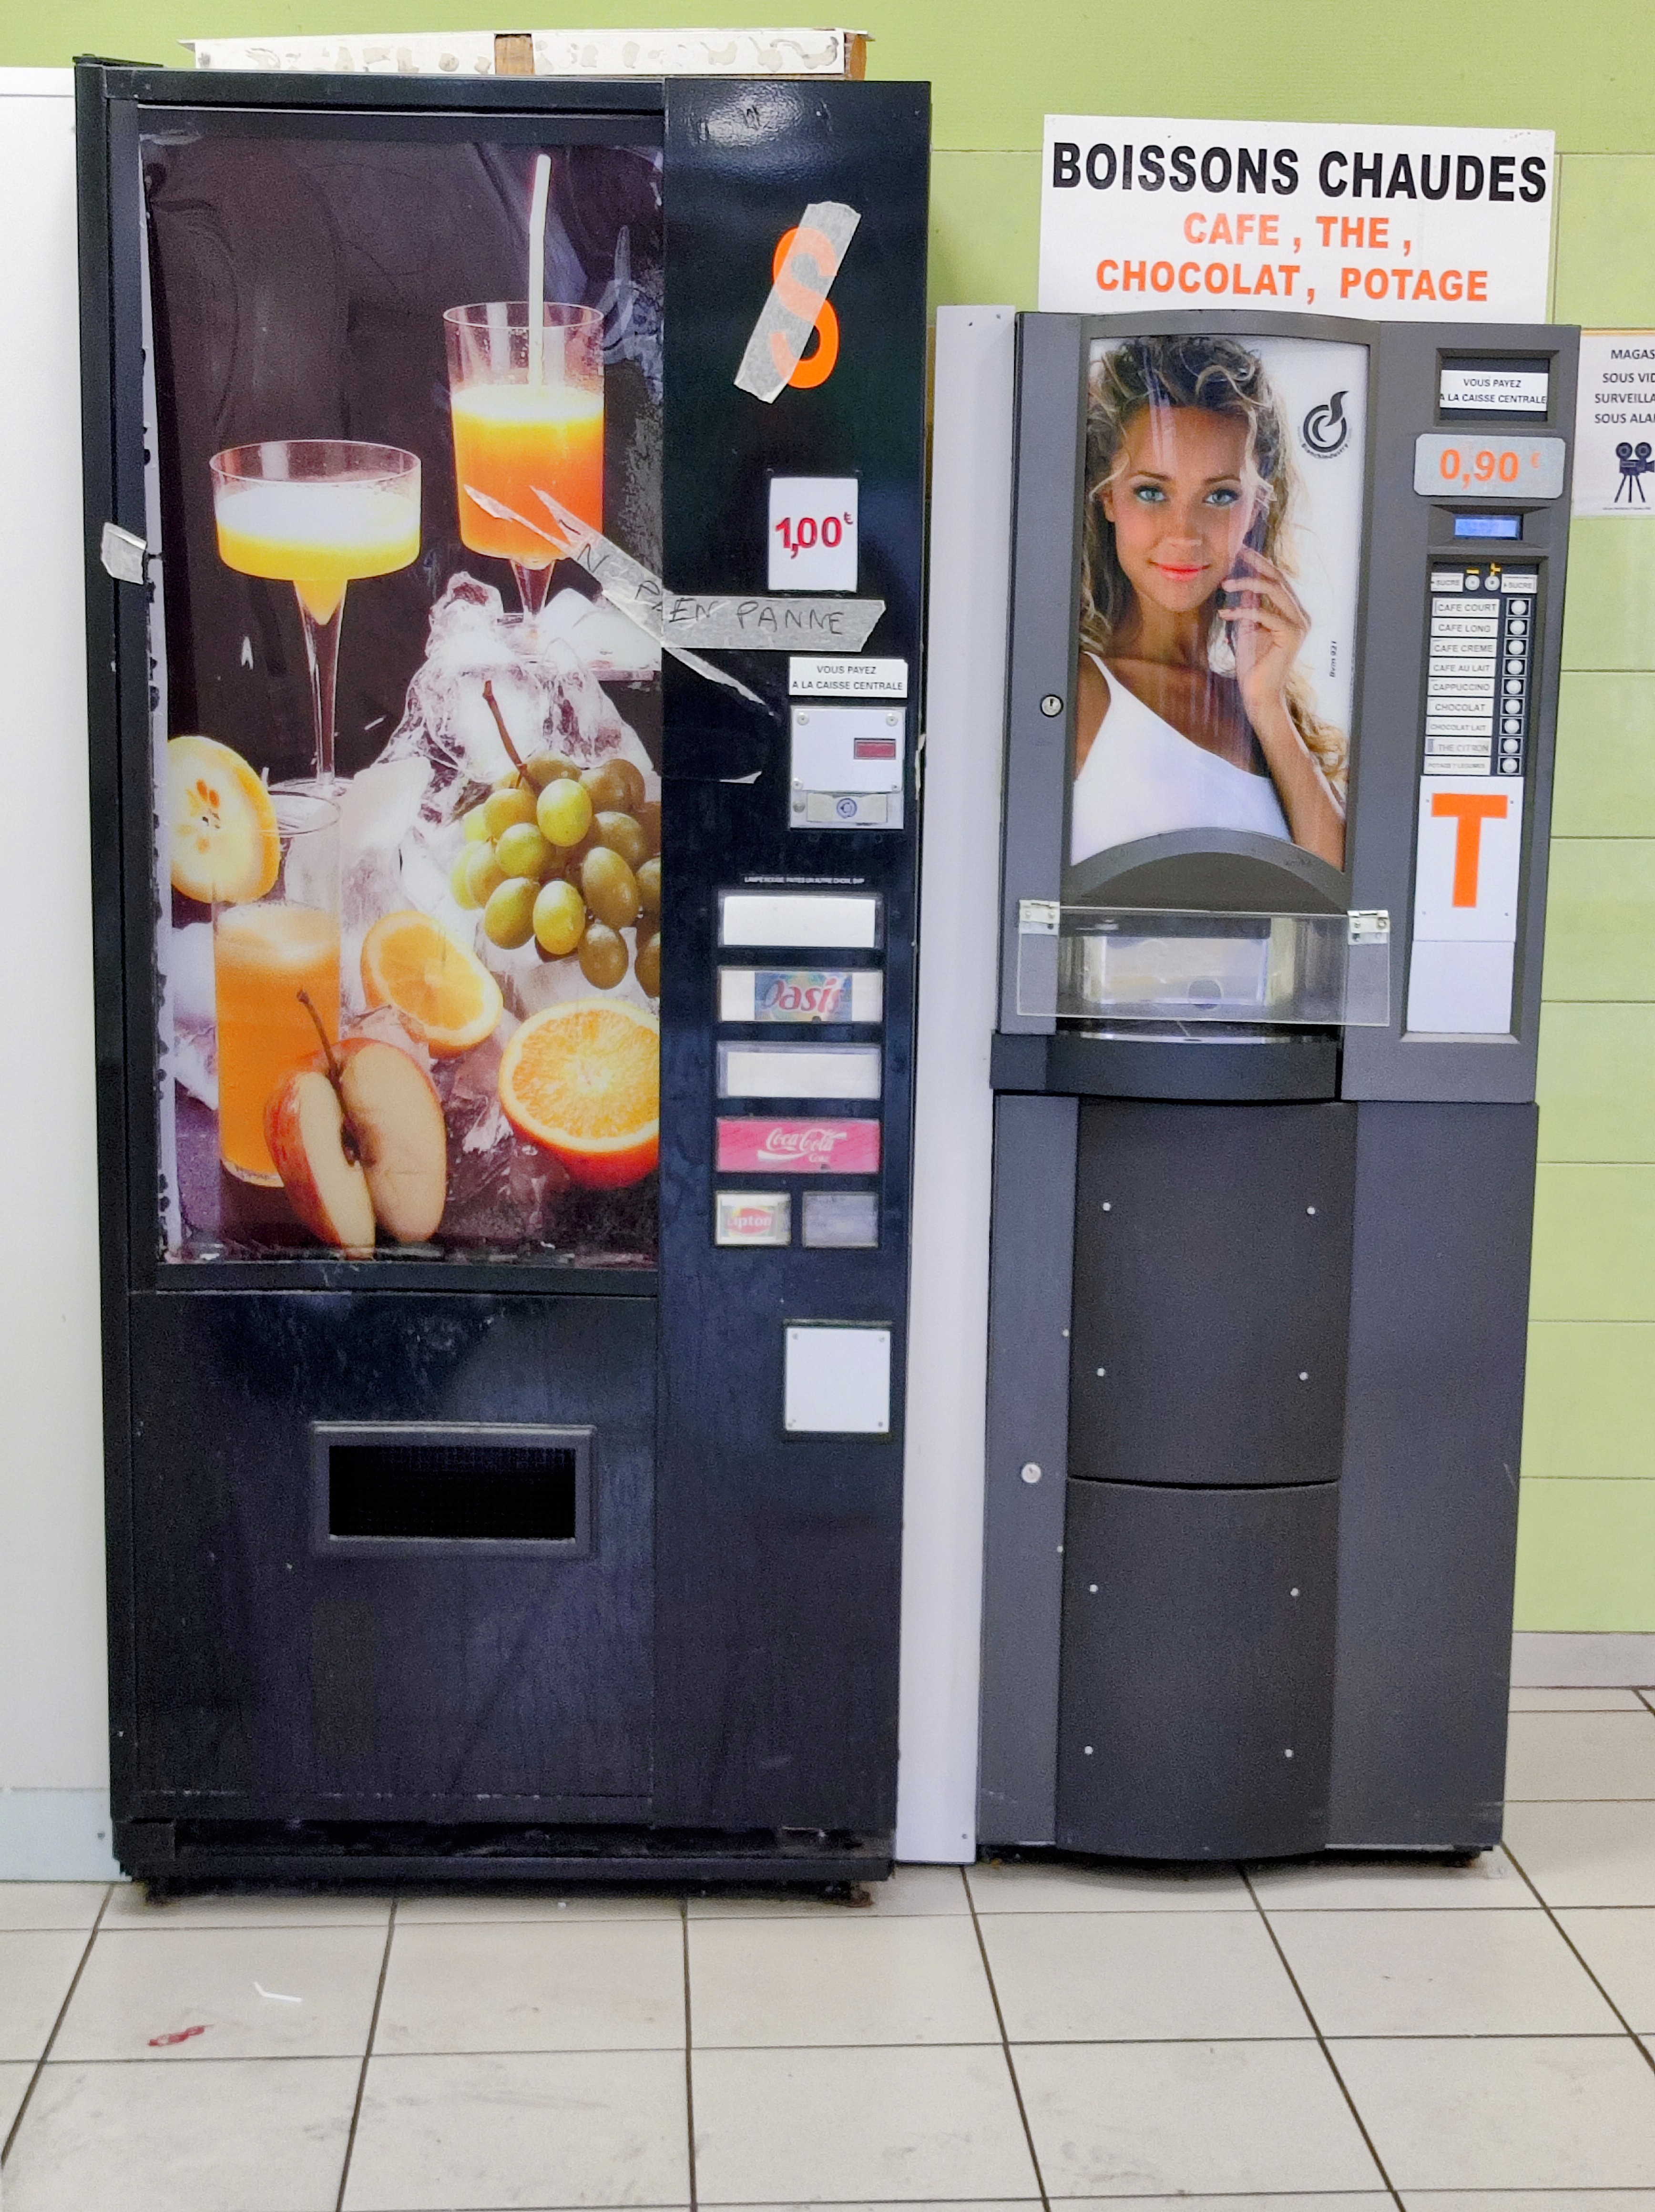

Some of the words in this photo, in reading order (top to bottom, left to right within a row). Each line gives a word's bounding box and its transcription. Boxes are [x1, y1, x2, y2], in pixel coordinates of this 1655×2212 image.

[1052, 142, 1298, 195] BOISSONS
[1319, 152, 1546, 203] CHAUDES
[1184, 212, 1279, 246] CAFE
[1316, 215, 1389, 248] THE
[1340, 267, 1488, 302] POTAGE
[1611, 349, 1655, 359] MAGAS
[1603, 373, 1634, 383] SOUS
[1463, 379, 1491, 387] VOUS
[1493, 379, 1522, 388] PAYEZ
[1462, 394, 1495, 402] CAISSE
[1498, 395, 1546, 404] CENTRALE
[1594, 413, 1626, 423] SOUS
[1630, 414, 1655, 423] ALA
[1440, 449, 1519, 490] 0,90
[1438, 604, 1462, 612] CAFE
[1464, 604, 1497, 612] COURT
[669, 597, 717, 623] EN
[736, 600, 844, 635] PANNE
[817, 666, 845, 674] VOUS
[848, 666, 876, 675] PAYEZ
[816, 681, 850, 689] CAISSE
[854, 682, 903, 690] CENTRALE
[1431, 793, 1508, 908] T
